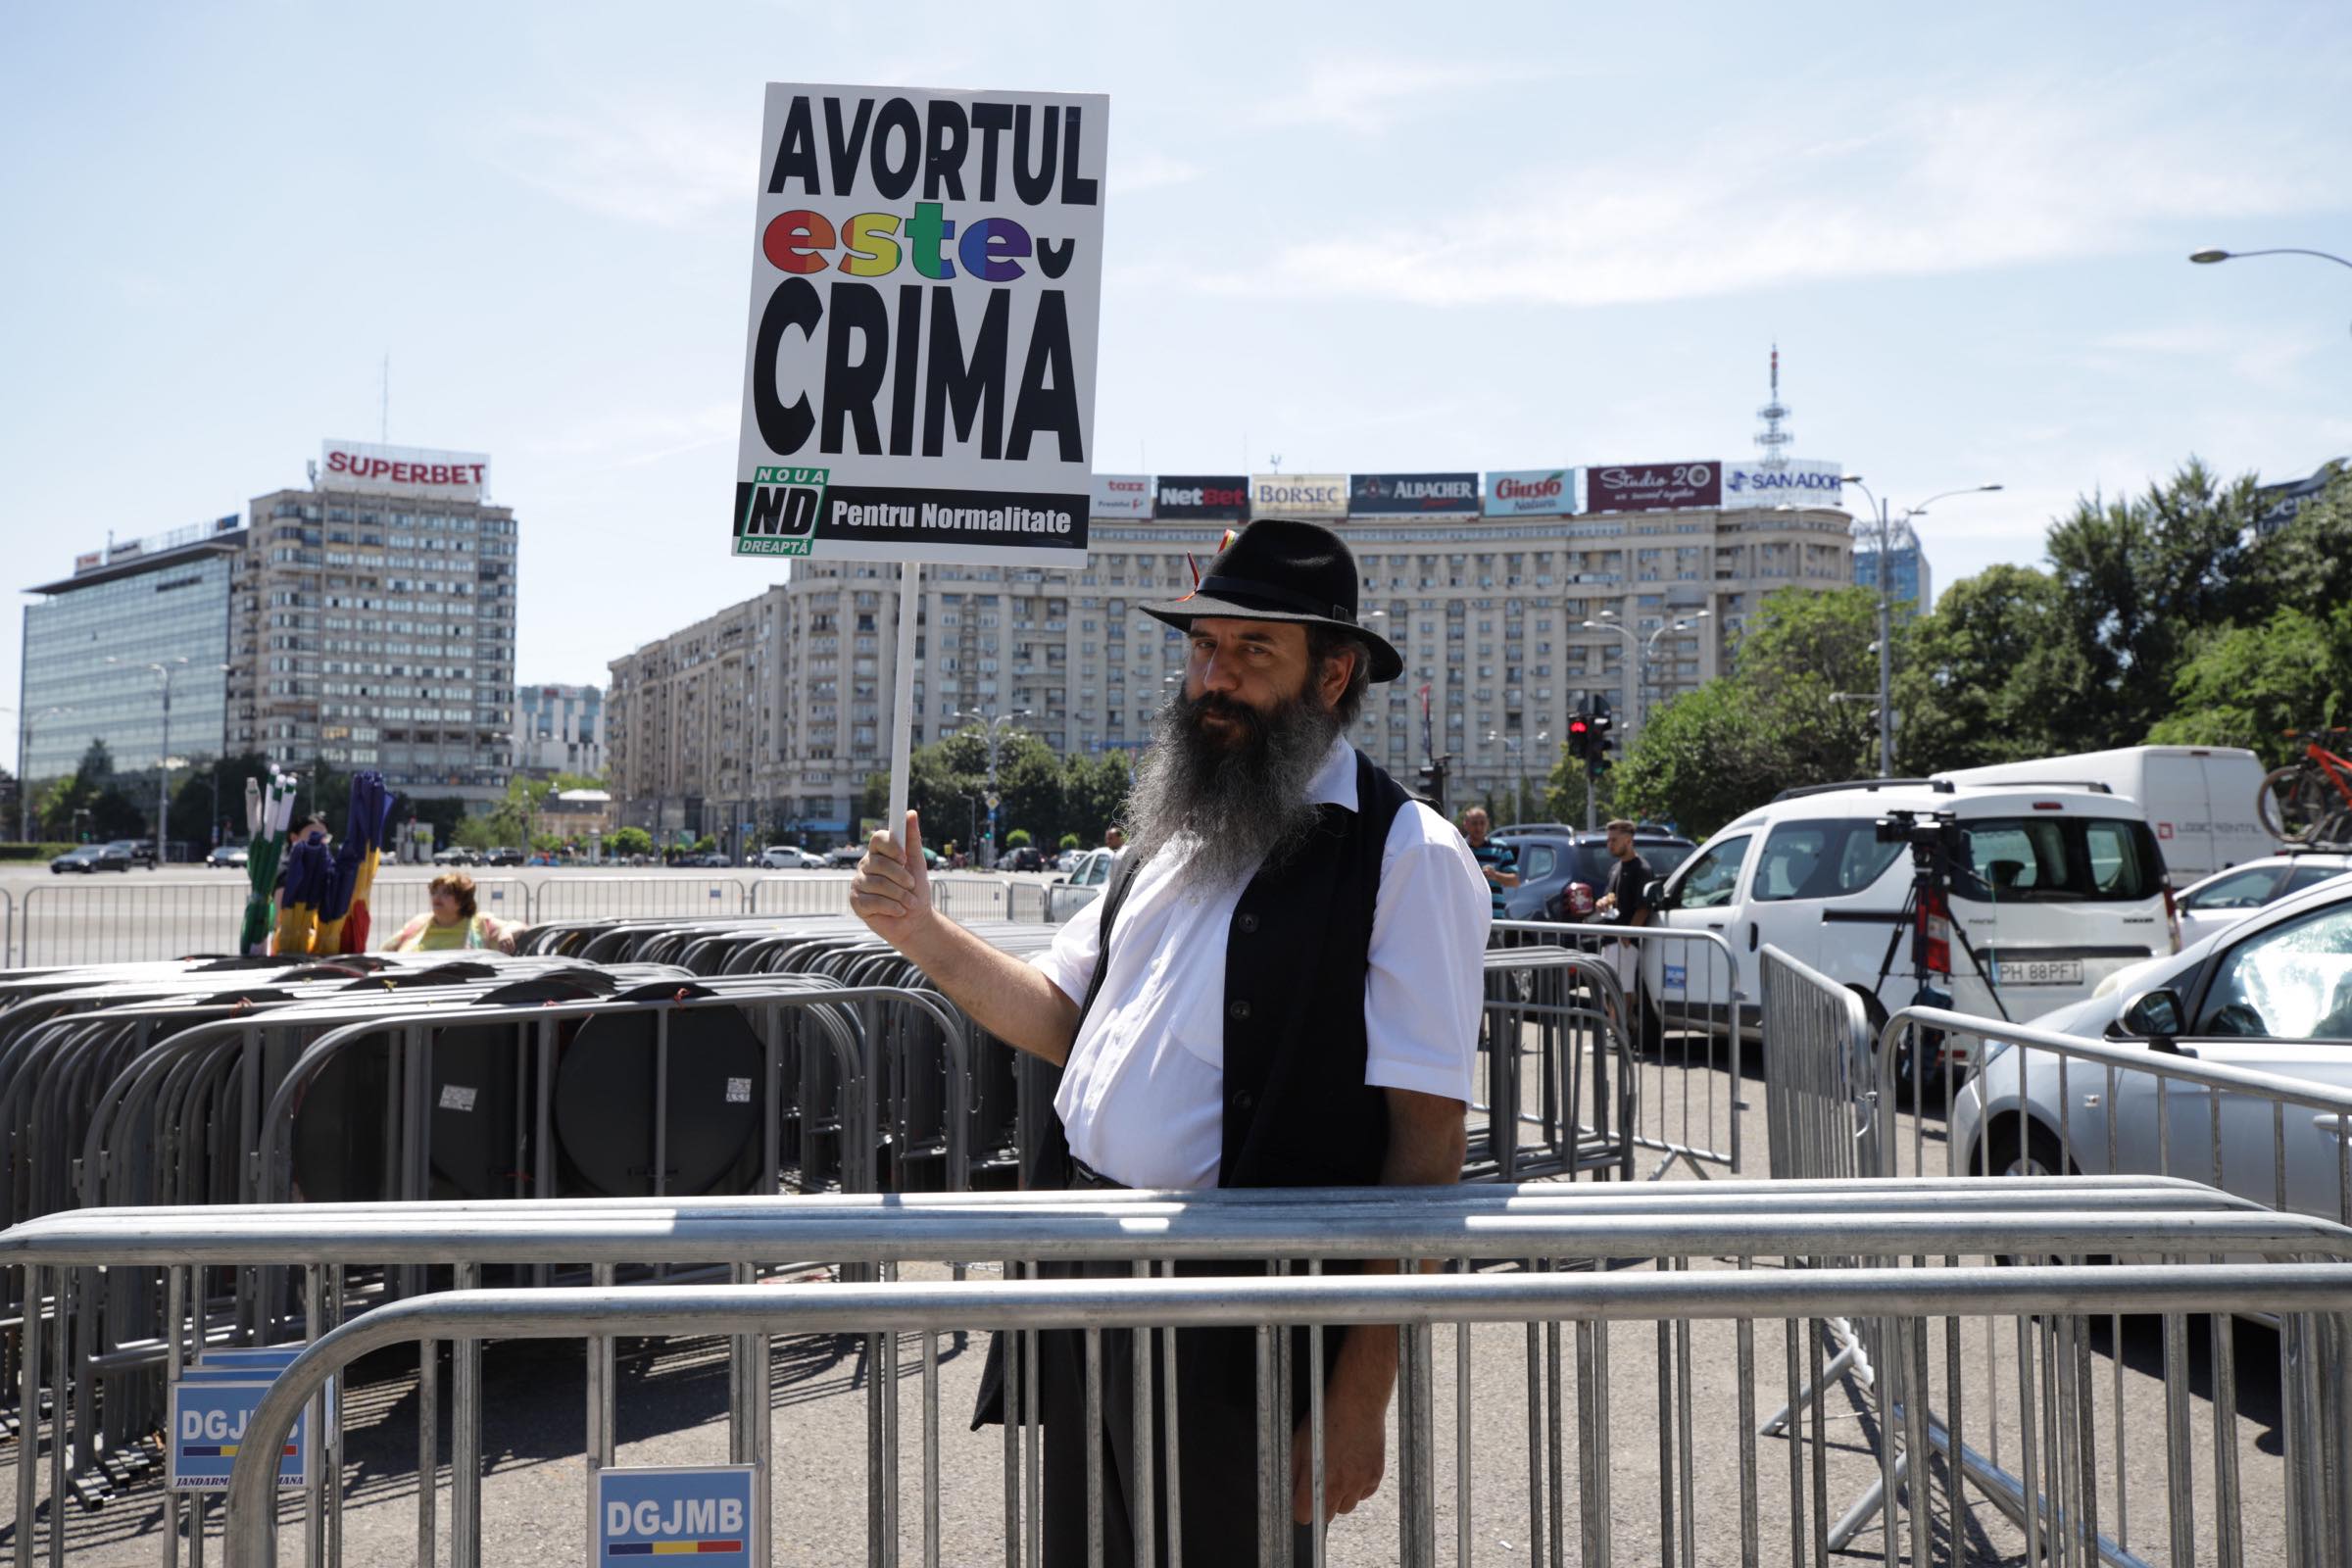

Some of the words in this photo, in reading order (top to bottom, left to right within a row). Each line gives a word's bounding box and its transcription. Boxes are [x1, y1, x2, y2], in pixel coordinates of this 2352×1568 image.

[767, 96, 1098, 206] AVORTUL
[762, 202, 1033, 282] este
[753, 237, 1085, 464] CRIMĂ
[327, 451, 486, 485] SUPERBET
[758, 468, 825, 484] NOUA
[1599, 467, 1668, 489] Studio
[1672, 465, 1711, 488] 20
[1394, 480, 1473, 499] ALBACHER
[1752, 472, 1841, 490] SANADOR
[1160, 487, 1246, 507] NetBet
[1259, 485, 1339, 503] BORSEC
[747, 486, 819, 536] ND
[832, 500, 915, 528] Pentru
[920, 503, 1072, 534] Normalitate
[741, 540, 809, 555] DREAPTĂ
[2000, 964, 2023, 980] PH
[182, 1409, 298, 1441] DGJ
[176, 1476, 231, 1487] JANDARM
[607, 1498, 744, 1537] DGJMB
